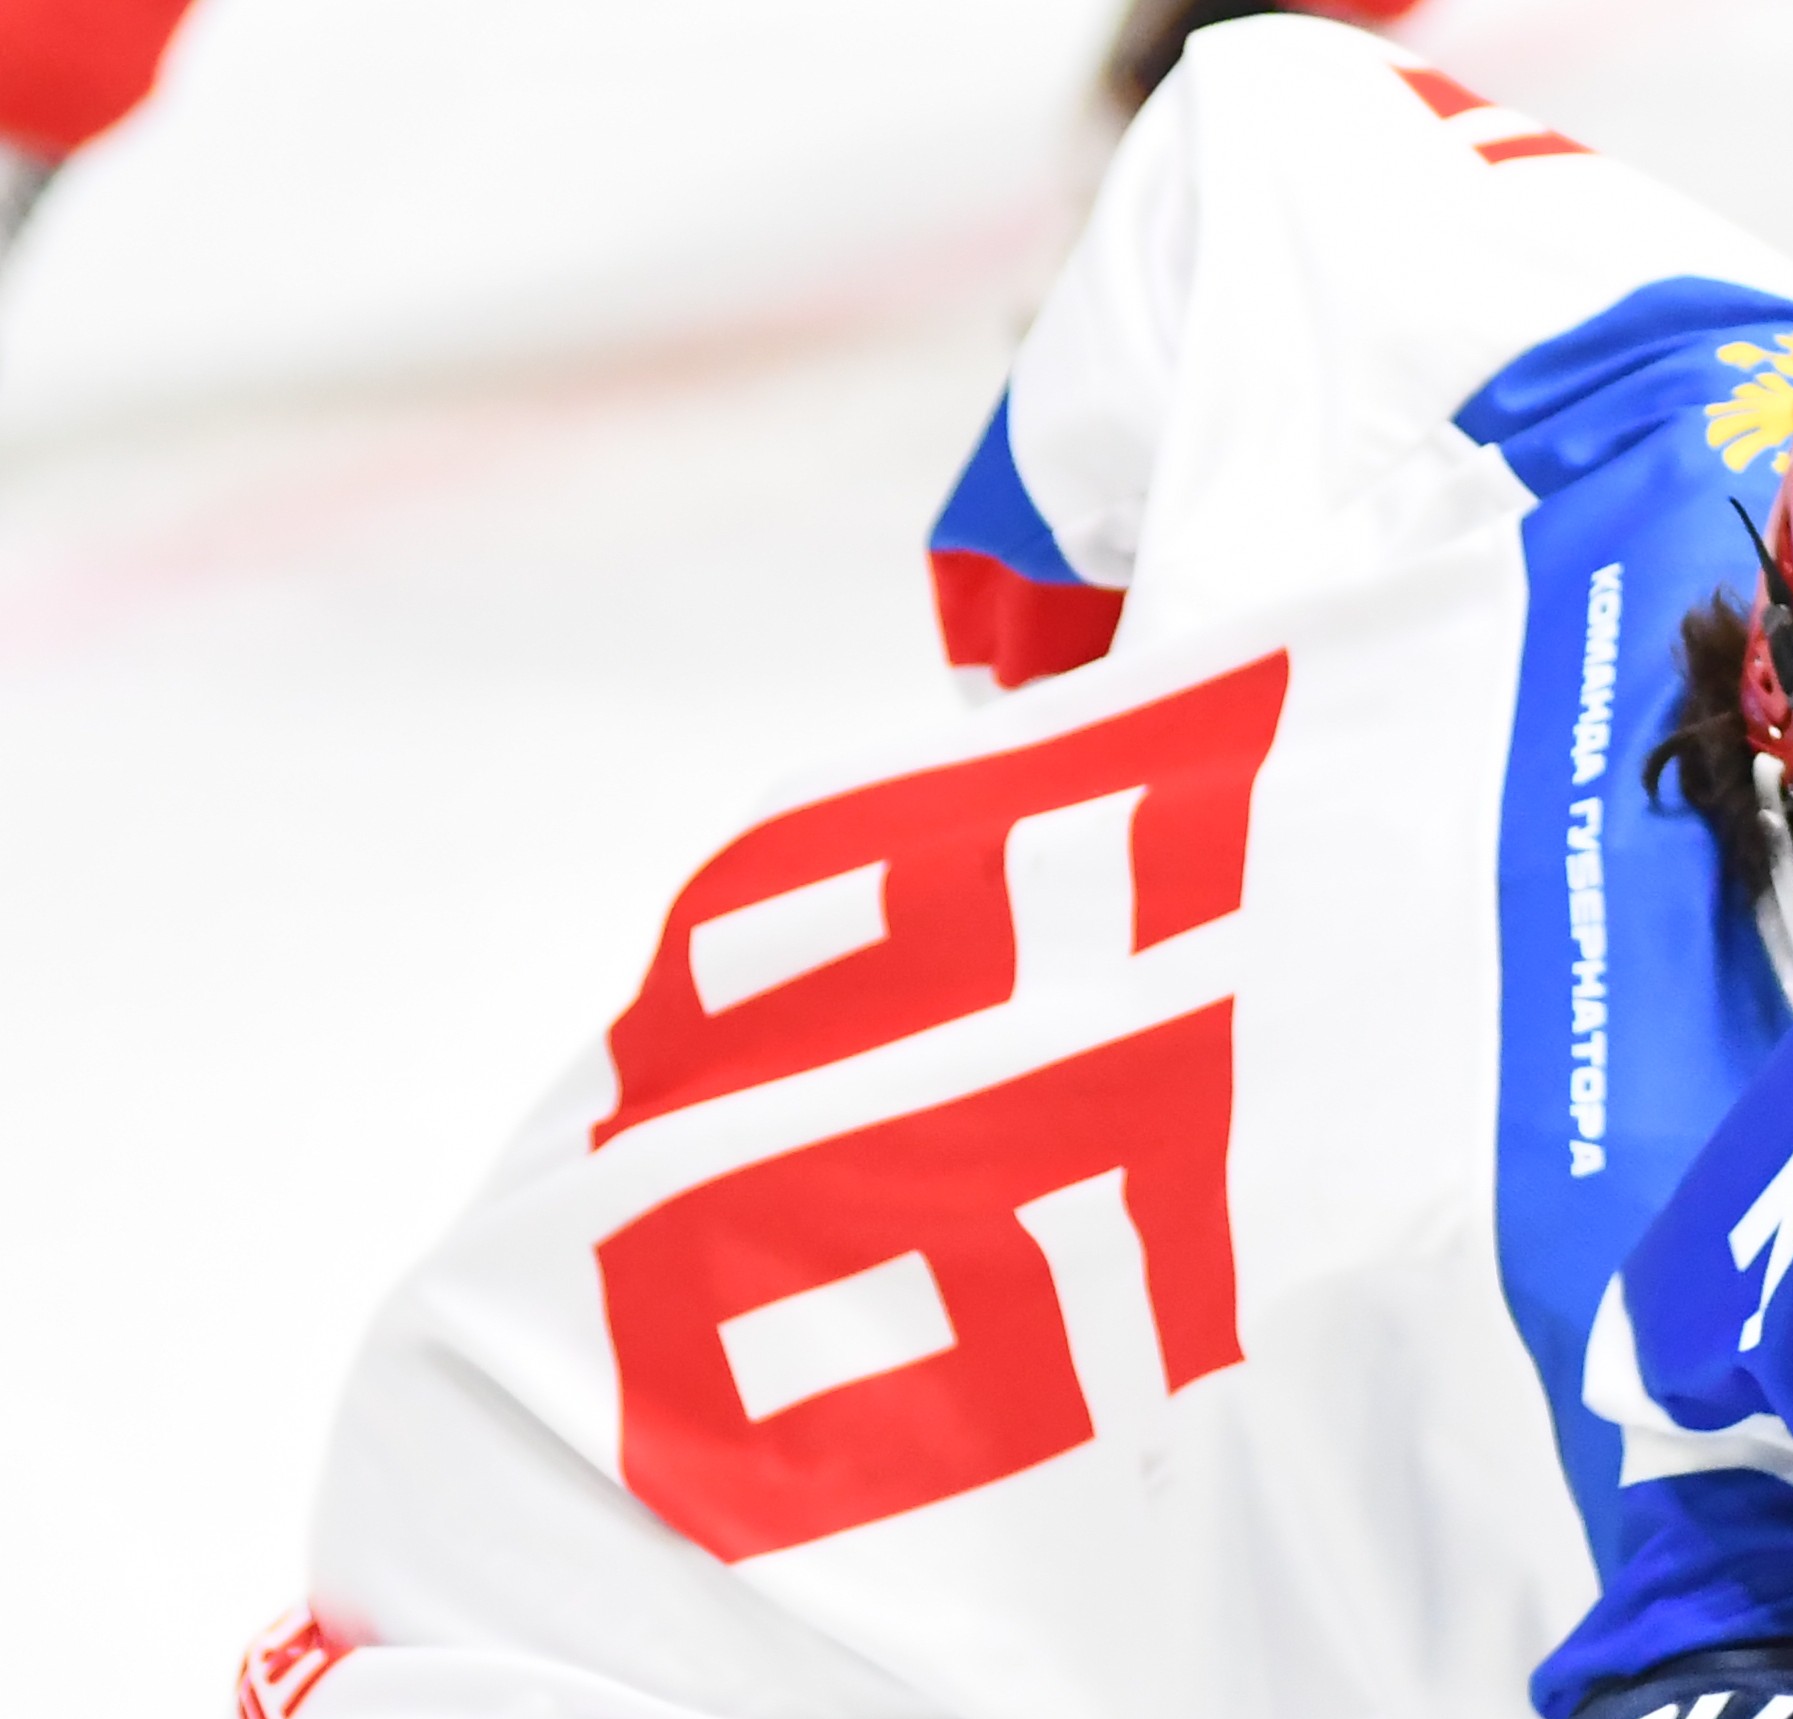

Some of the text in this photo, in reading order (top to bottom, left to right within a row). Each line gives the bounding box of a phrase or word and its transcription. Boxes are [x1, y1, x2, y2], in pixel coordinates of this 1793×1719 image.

[590, 647, 1290, 1565] 66
[1565, 562, 1623, 1179] КОМАНДА ГУБЕРНАТОРА
